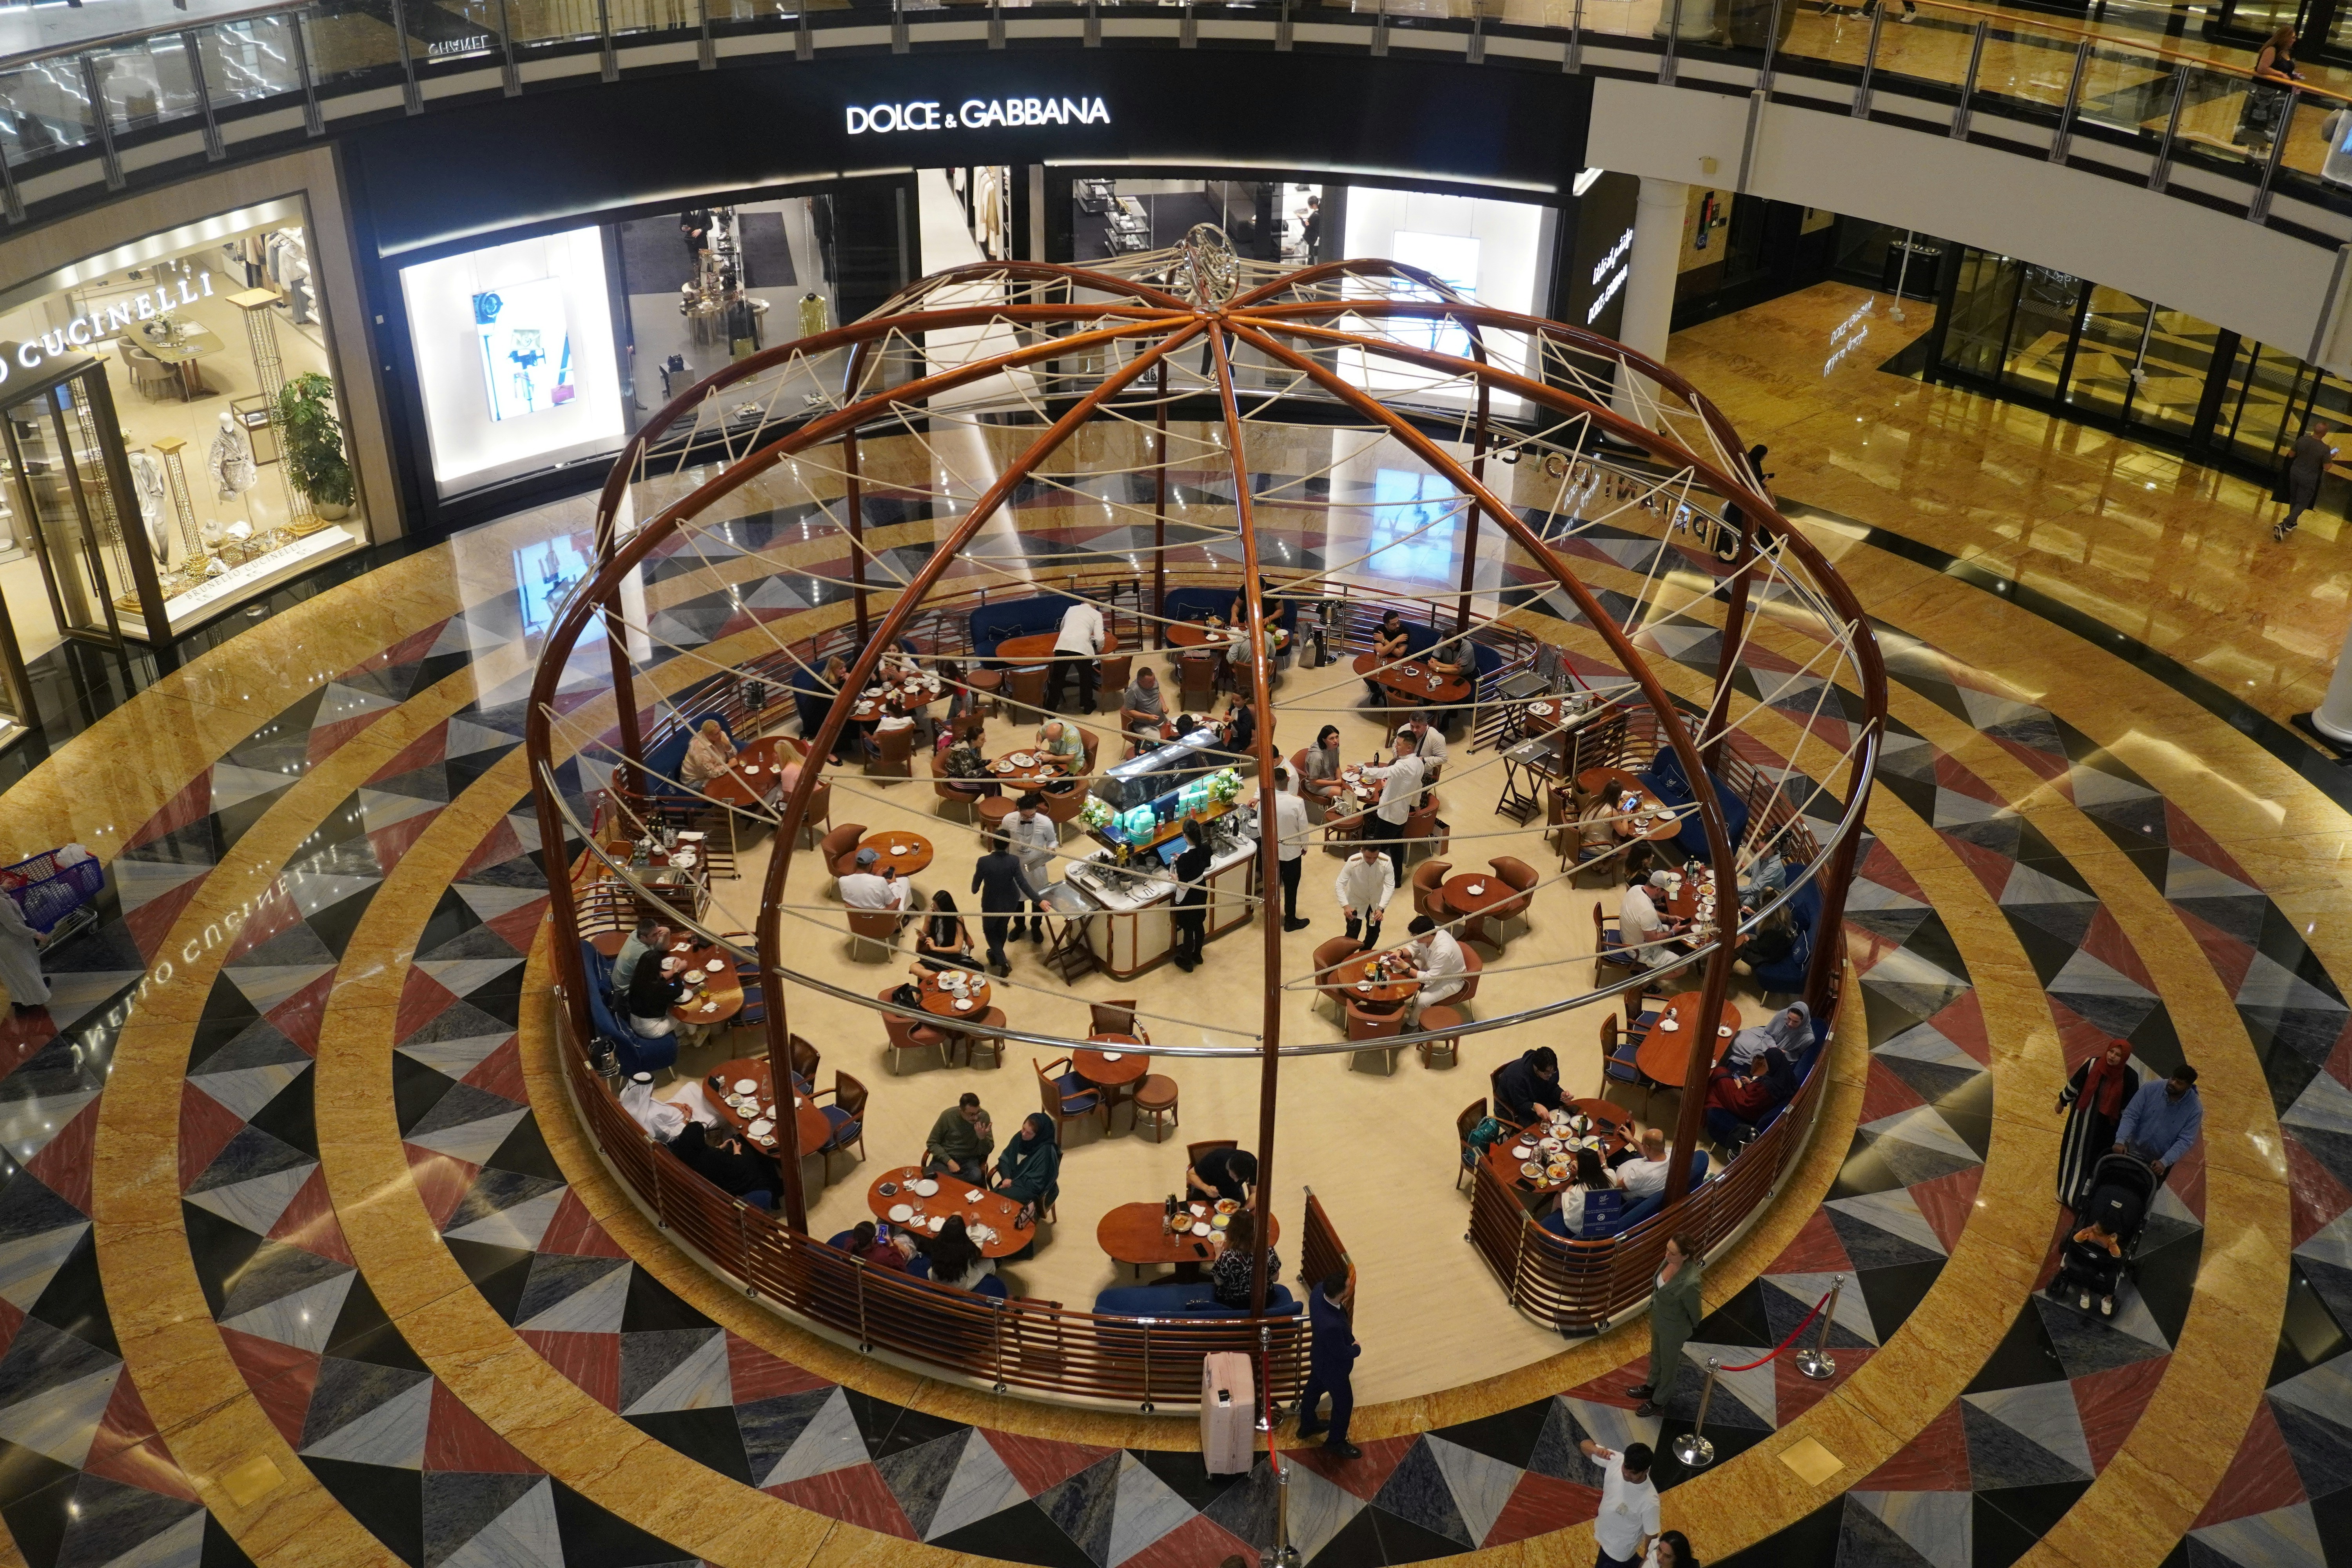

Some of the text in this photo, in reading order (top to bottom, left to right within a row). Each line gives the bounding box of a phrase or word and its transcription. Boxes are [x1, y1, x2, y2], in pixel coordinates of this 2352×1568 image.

[846, 98, 1110, 134] DOLCE & GABBANA
[18, 272, 214, 368] CUCINELLI
[185, 543, 301, 600] BRUNELLO CUCINELLI
